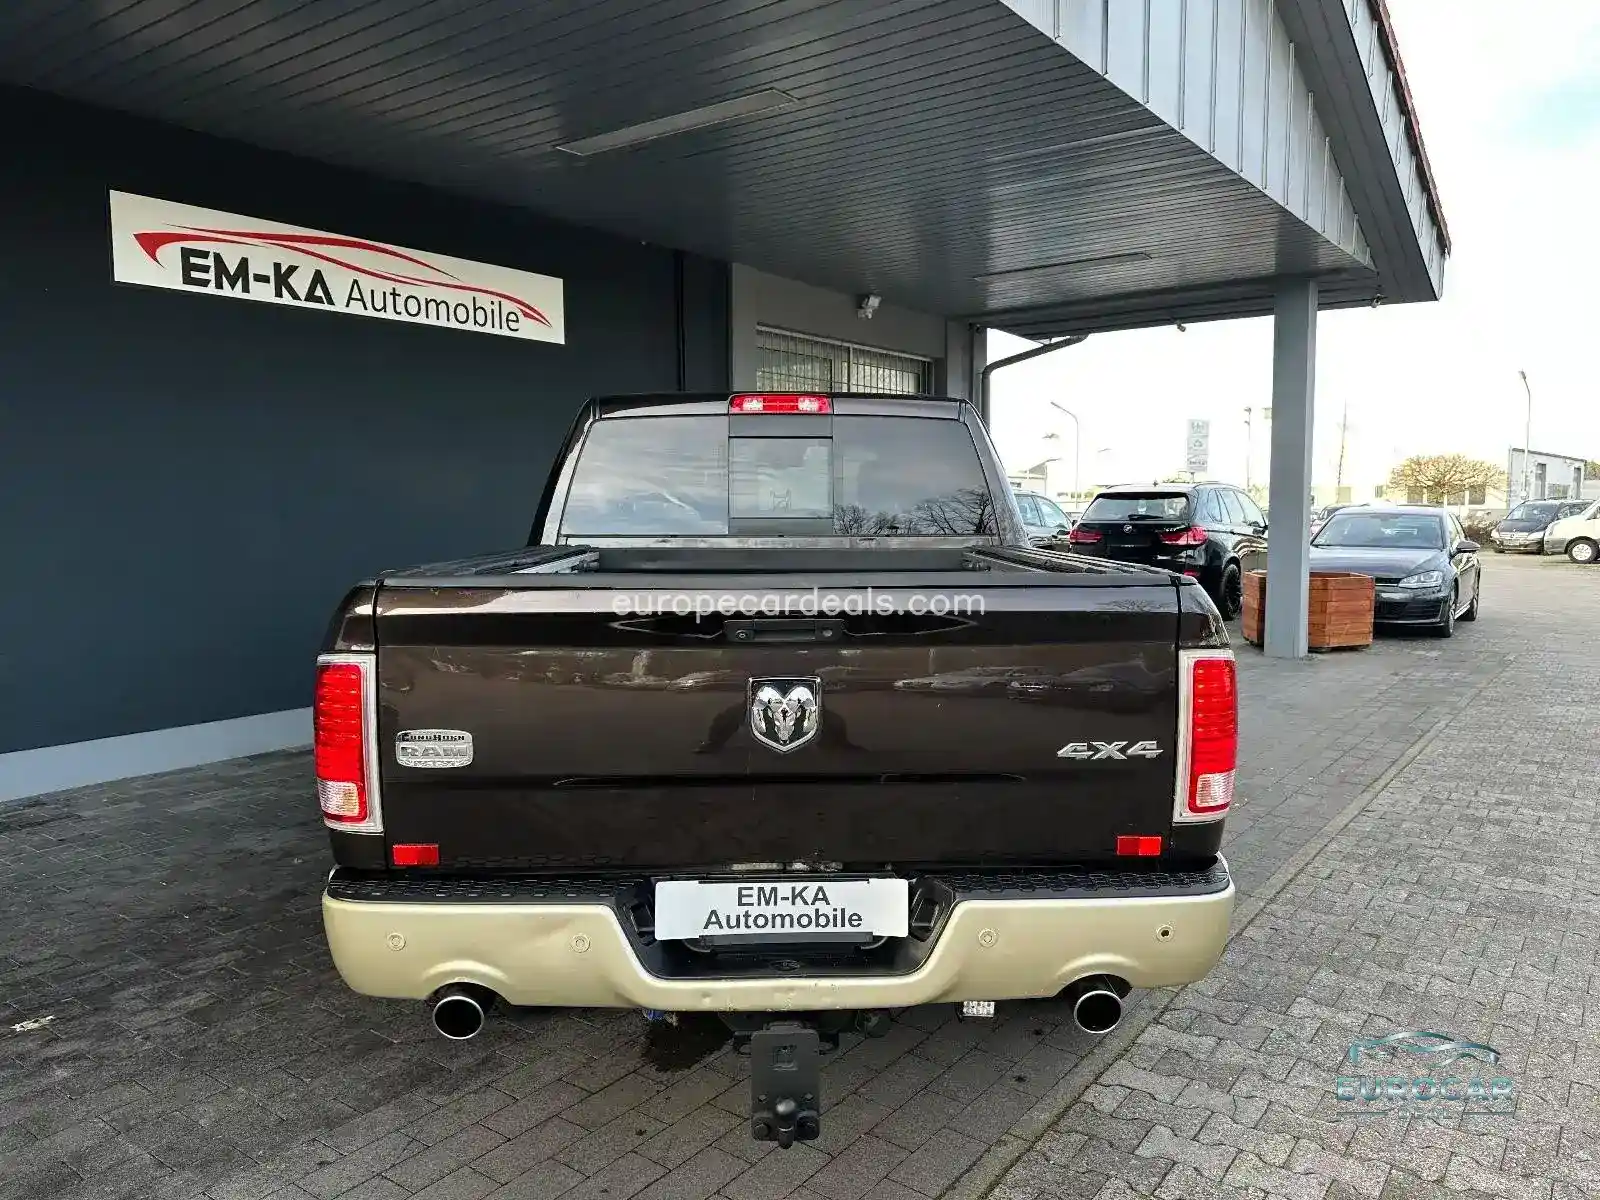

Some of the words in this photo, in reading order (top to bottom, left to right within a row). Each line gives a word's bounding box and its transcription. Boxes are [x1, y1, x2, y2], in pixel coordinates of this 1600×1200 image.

[180, 246, 335, 307] EM-KA
[345, 278, 521, 333] Automobile
[400, 745, 469, 758] RAM
[737, 885, 831, 907] EM-KA
[703, 907, 863, 930] Automobile
